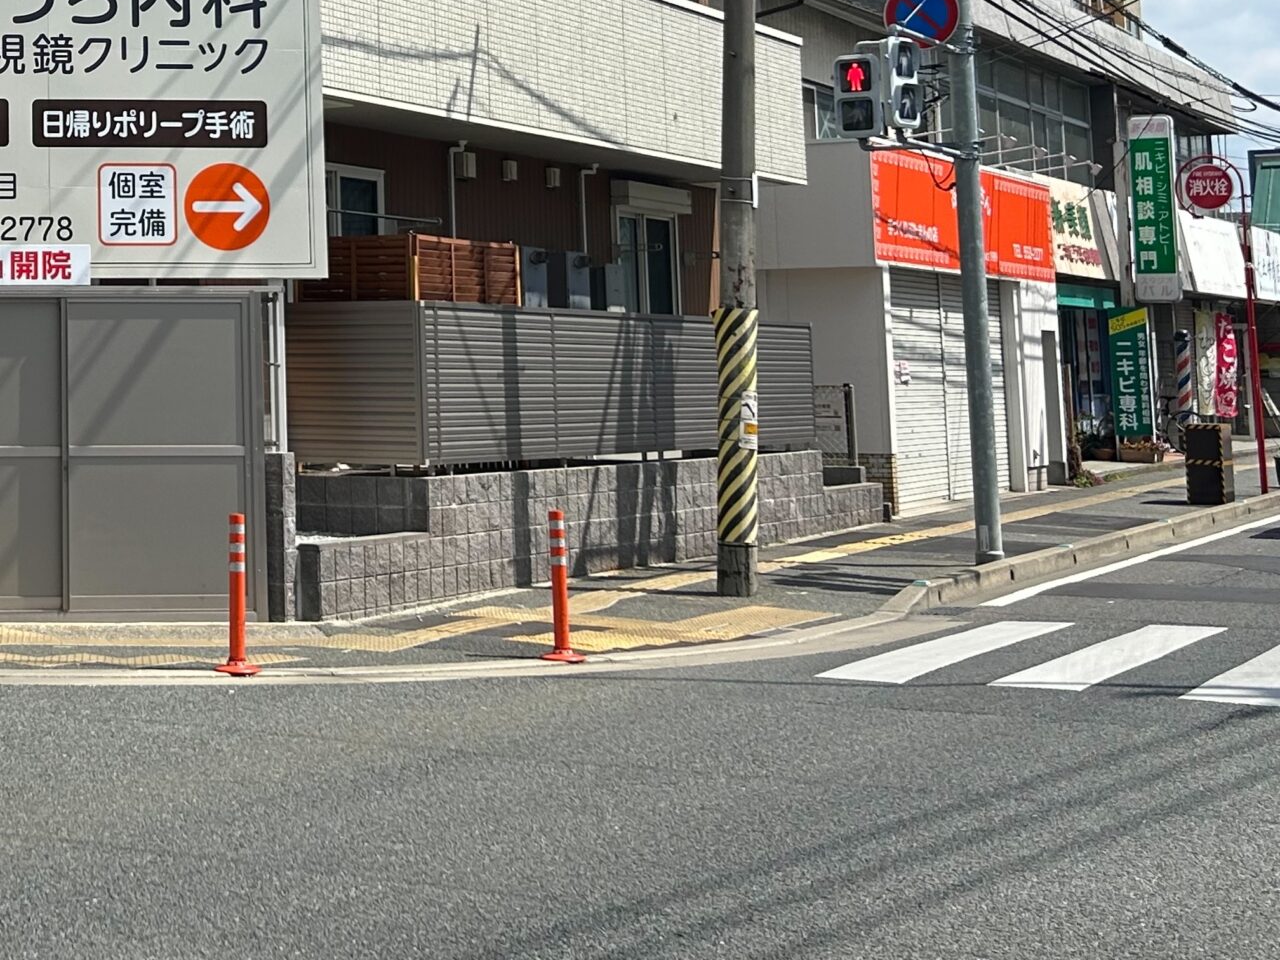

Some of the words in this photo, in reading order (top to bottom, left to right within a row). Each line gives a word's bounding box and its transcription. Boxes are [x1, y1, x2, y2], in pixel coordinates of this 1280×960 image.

[42, 109, 256, 141] 日帰りポリープ手術
[108, 171, 167, 201] 個室
[1188, 178, 1229, 197] 消火栓
[109, 208, 167, 238] 完備
[1135, 151, 1158, 271] 肌相談専門
[1115, 341, 1139, 431] ニキビ専科
